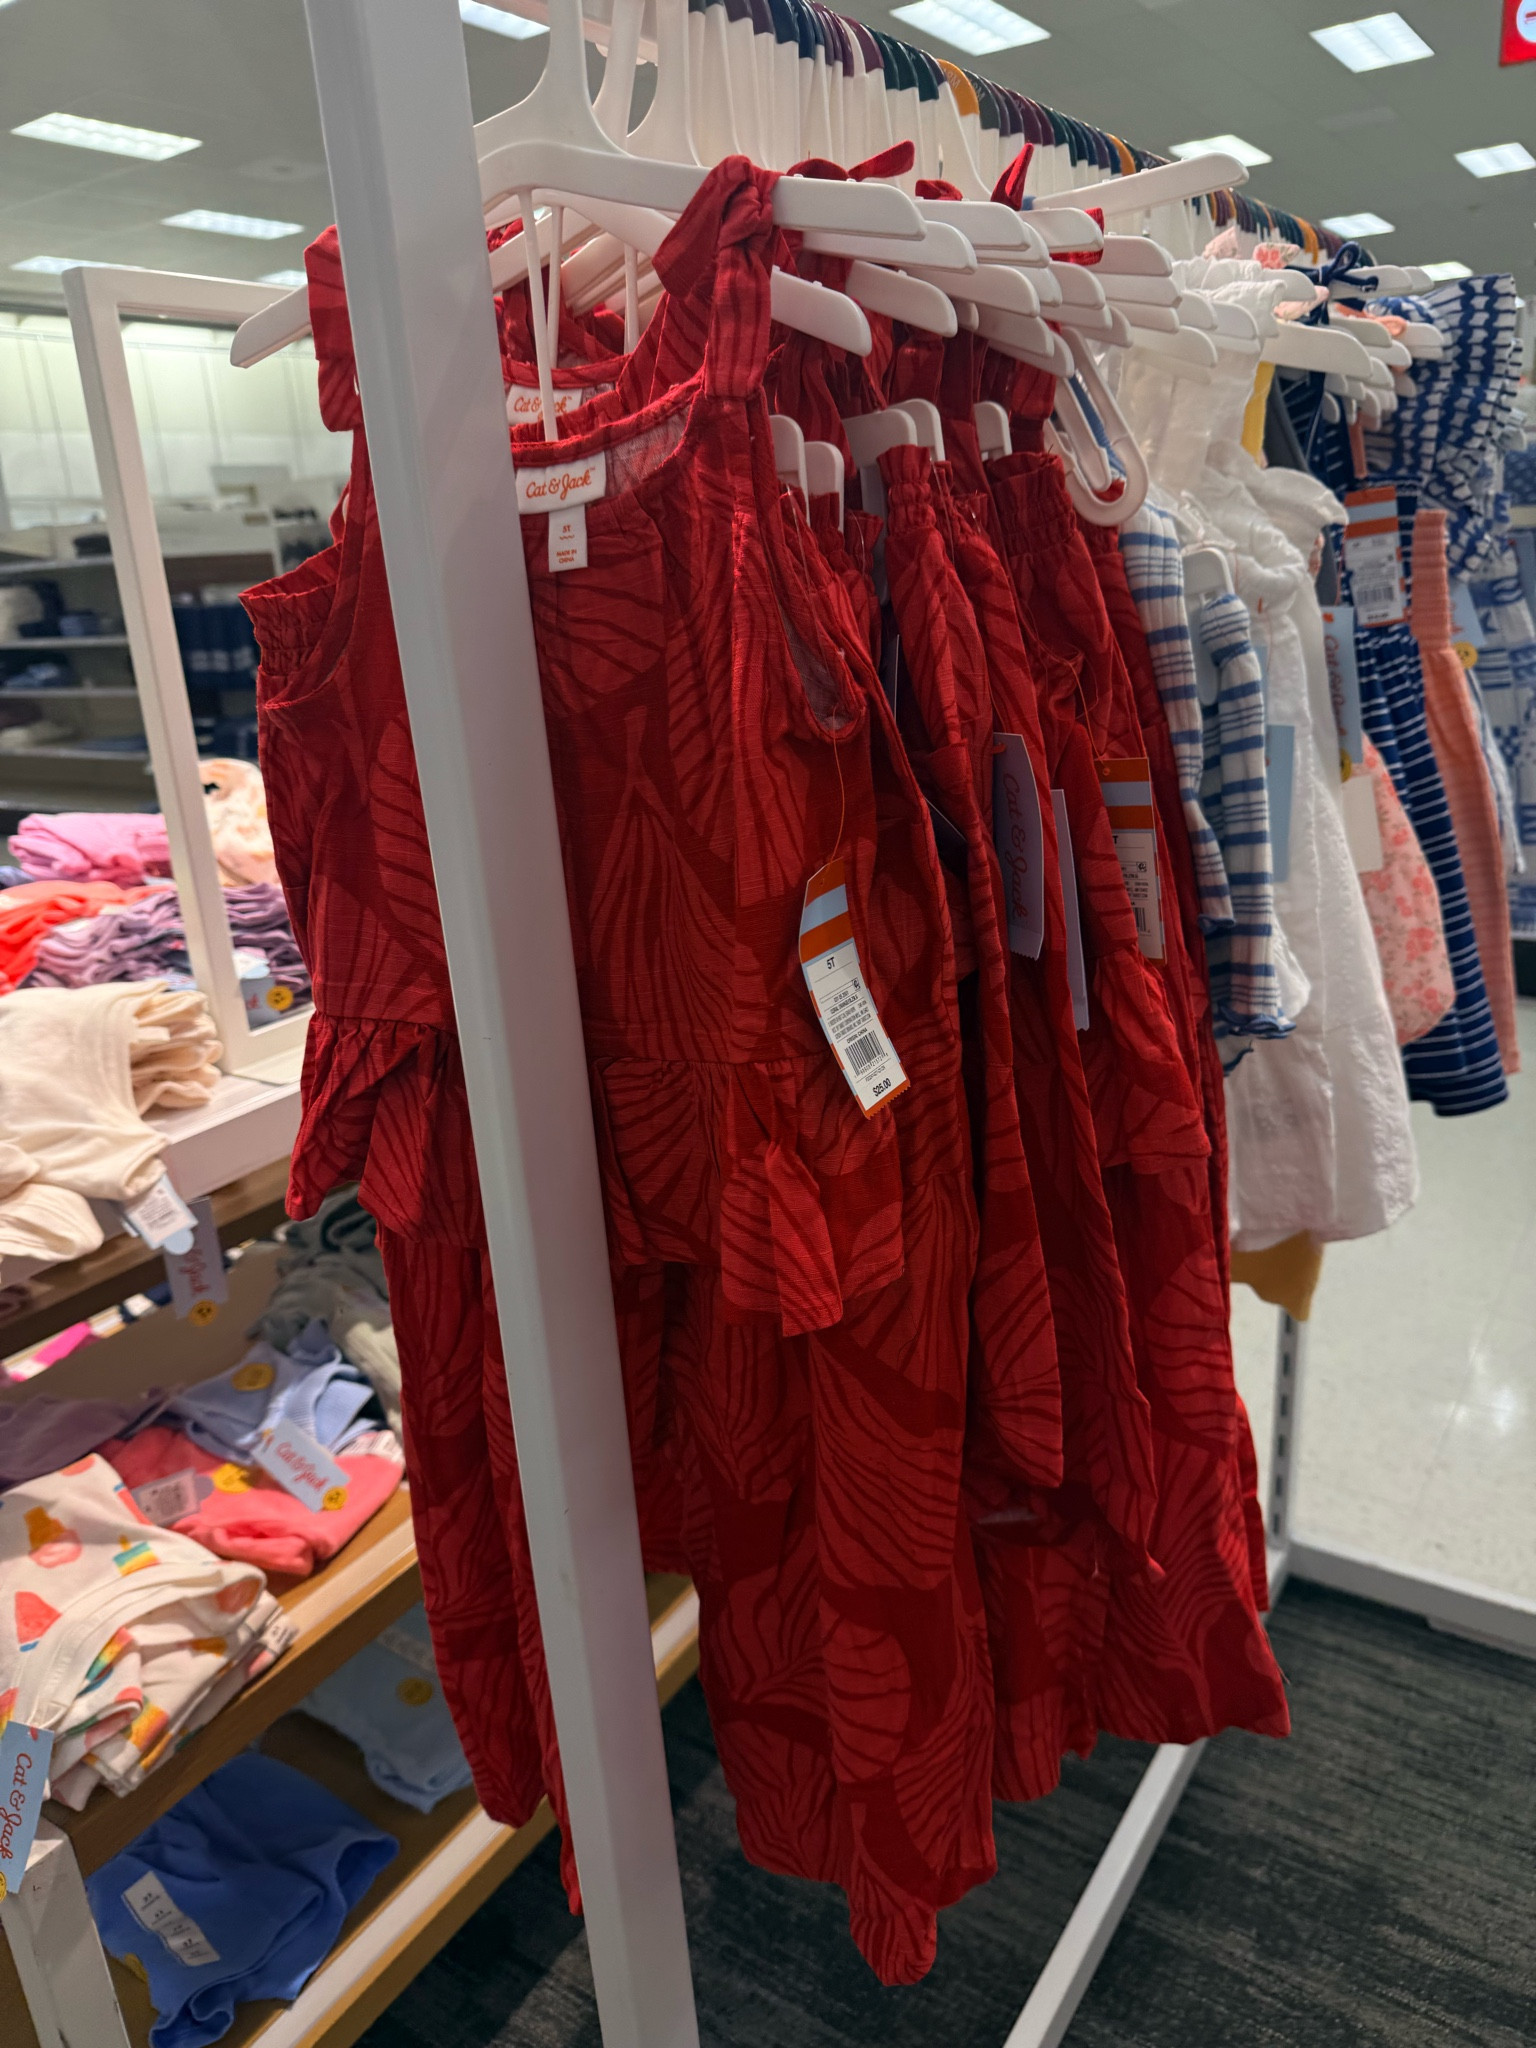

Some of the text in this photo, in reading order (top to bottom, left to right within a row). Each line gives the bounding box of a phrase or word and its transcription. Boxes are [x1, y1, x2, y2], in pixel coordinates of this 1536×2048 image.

[514, 396, 531, 412] Cat
[525, 469, 592, 501] Cat & Jack
[1003, 772, 1029, 918] Cat & Jack
[826, 956, 835, 970] 5T
[873, 1078, 891, 1097] $25.00
[0, 1752, 33, 1860] Cat & Jack
